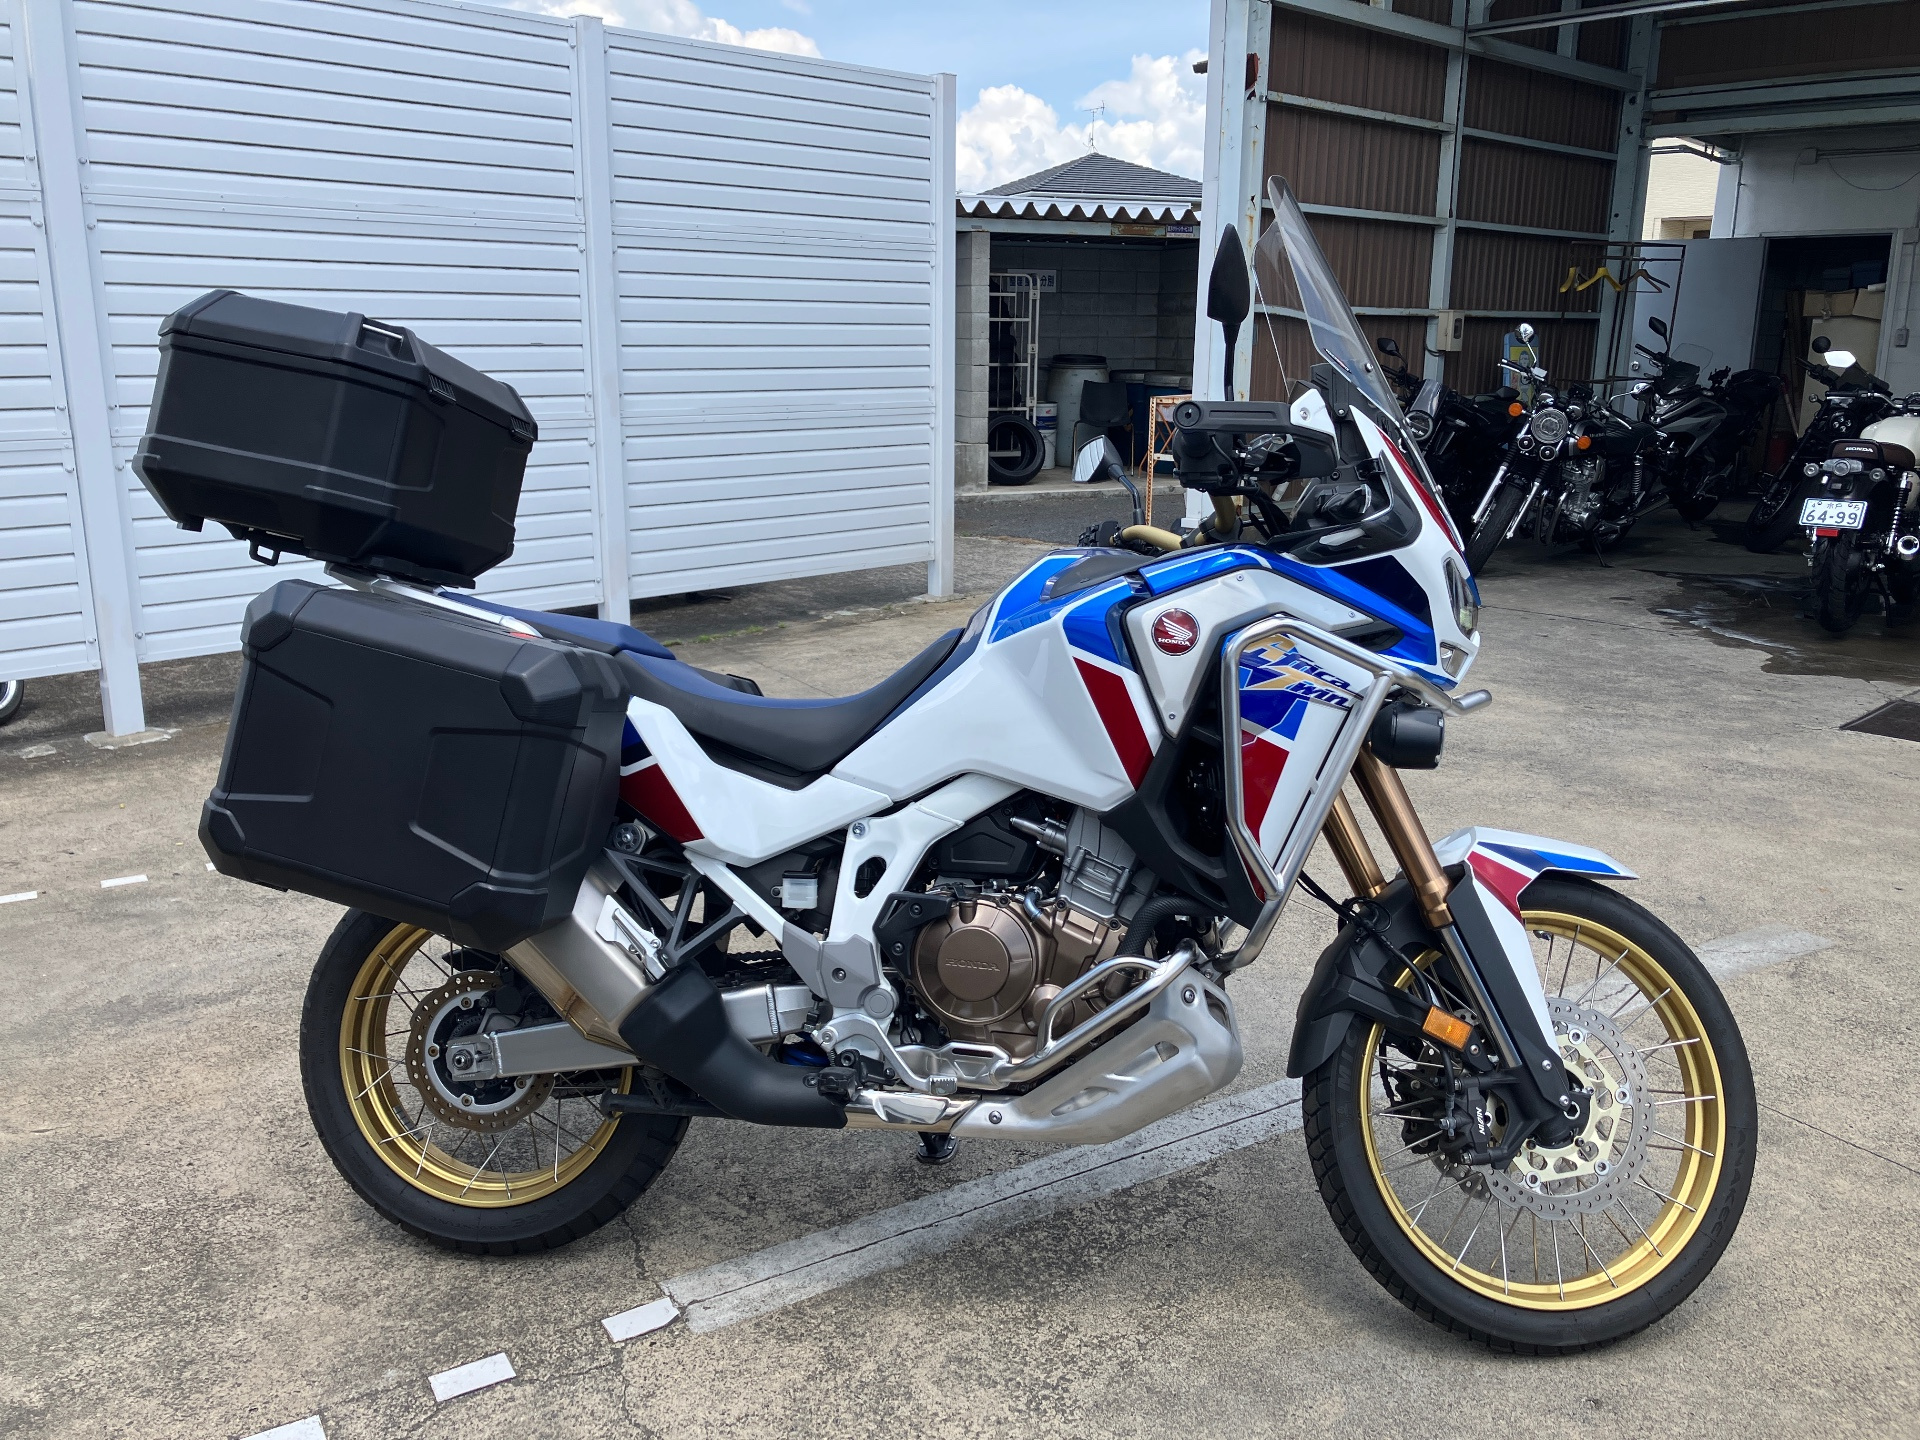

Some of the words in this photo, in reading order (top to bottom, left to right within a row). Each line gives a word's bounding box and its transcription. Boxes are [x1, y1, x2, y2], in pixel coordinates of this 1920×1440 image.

[1805, 509, 1858, 525] 64-99
[1157, 637, 1192, 647] HONDA
[944, 956, 1001, 973] HONDA
